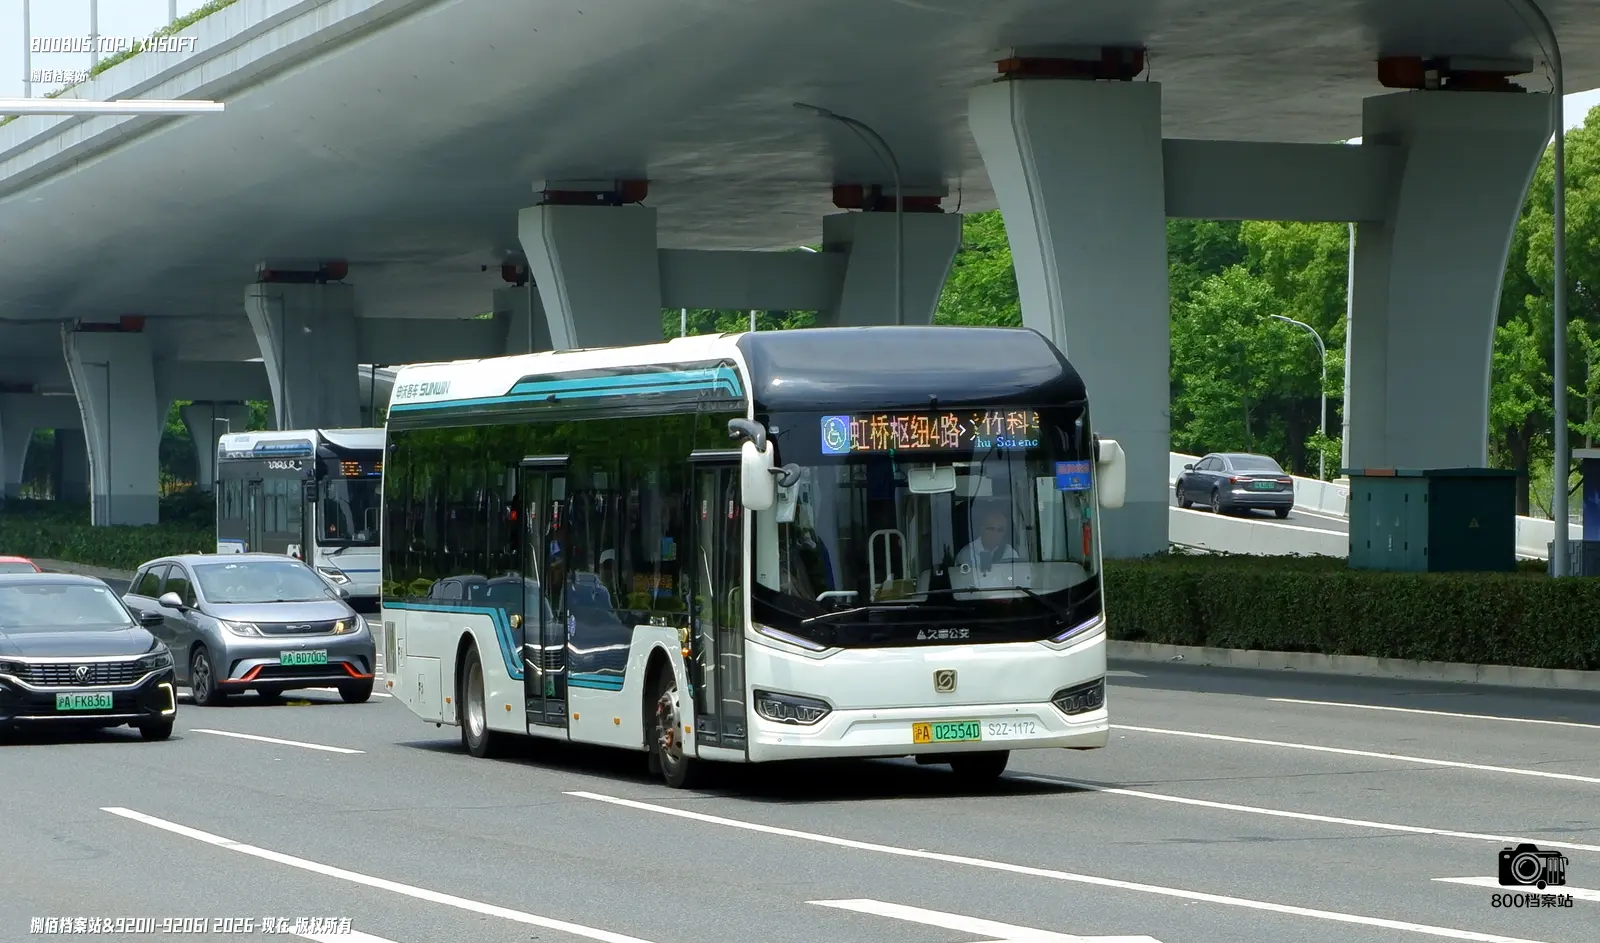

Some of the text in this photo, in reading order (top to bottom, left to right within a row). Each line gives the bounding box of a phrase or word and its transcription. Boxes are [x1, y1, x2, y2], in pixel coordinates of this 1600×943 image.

[419, 381, 451, 396] SUNWIN
[850, 412, 960, 451] 虹桥枢纽4路
[74, 694, 112, 708] FK8361
[935, 723, 980, 740] 02554D
[988, 721, 1036, 736] S2Z-1172
